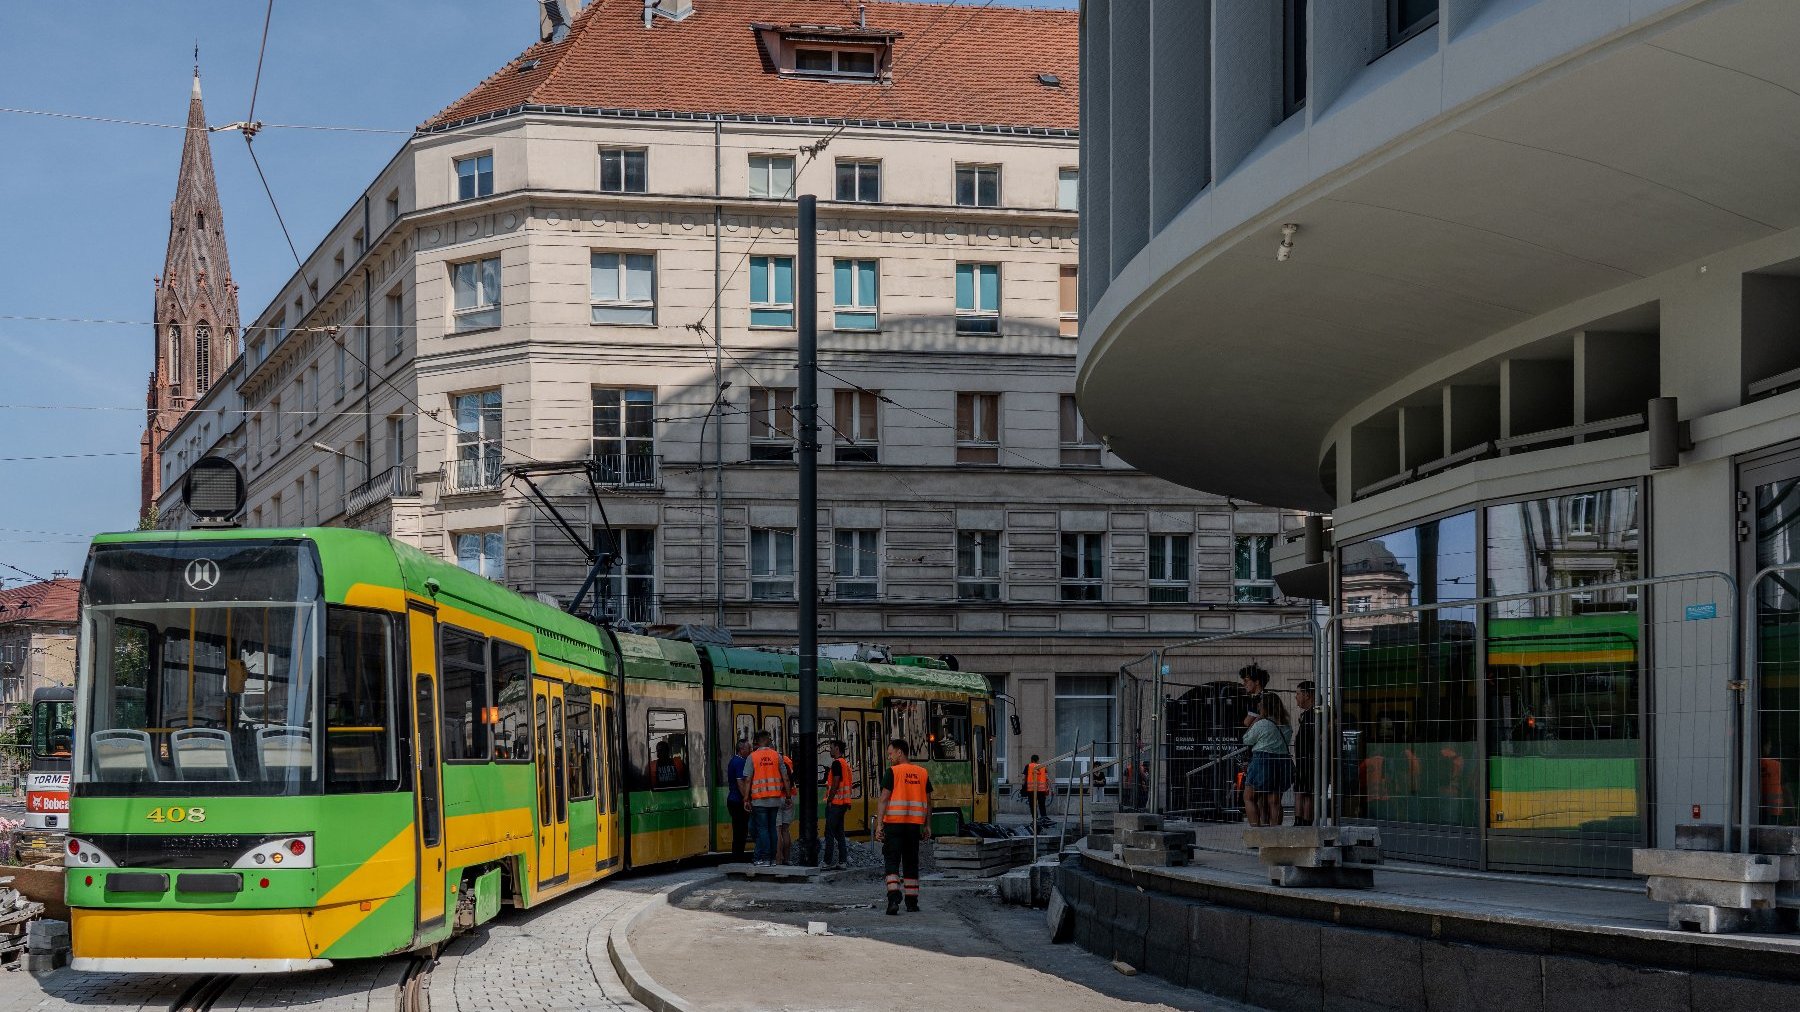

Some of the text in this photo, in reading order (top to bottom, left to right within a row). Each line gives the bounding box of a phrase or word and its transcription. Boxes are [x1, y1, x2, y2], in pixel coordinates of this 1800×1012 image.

[34, 775, 70, 784] TORME
[43, 797, 70, 810] Bobca
[145, 806, 206, 824] 408
